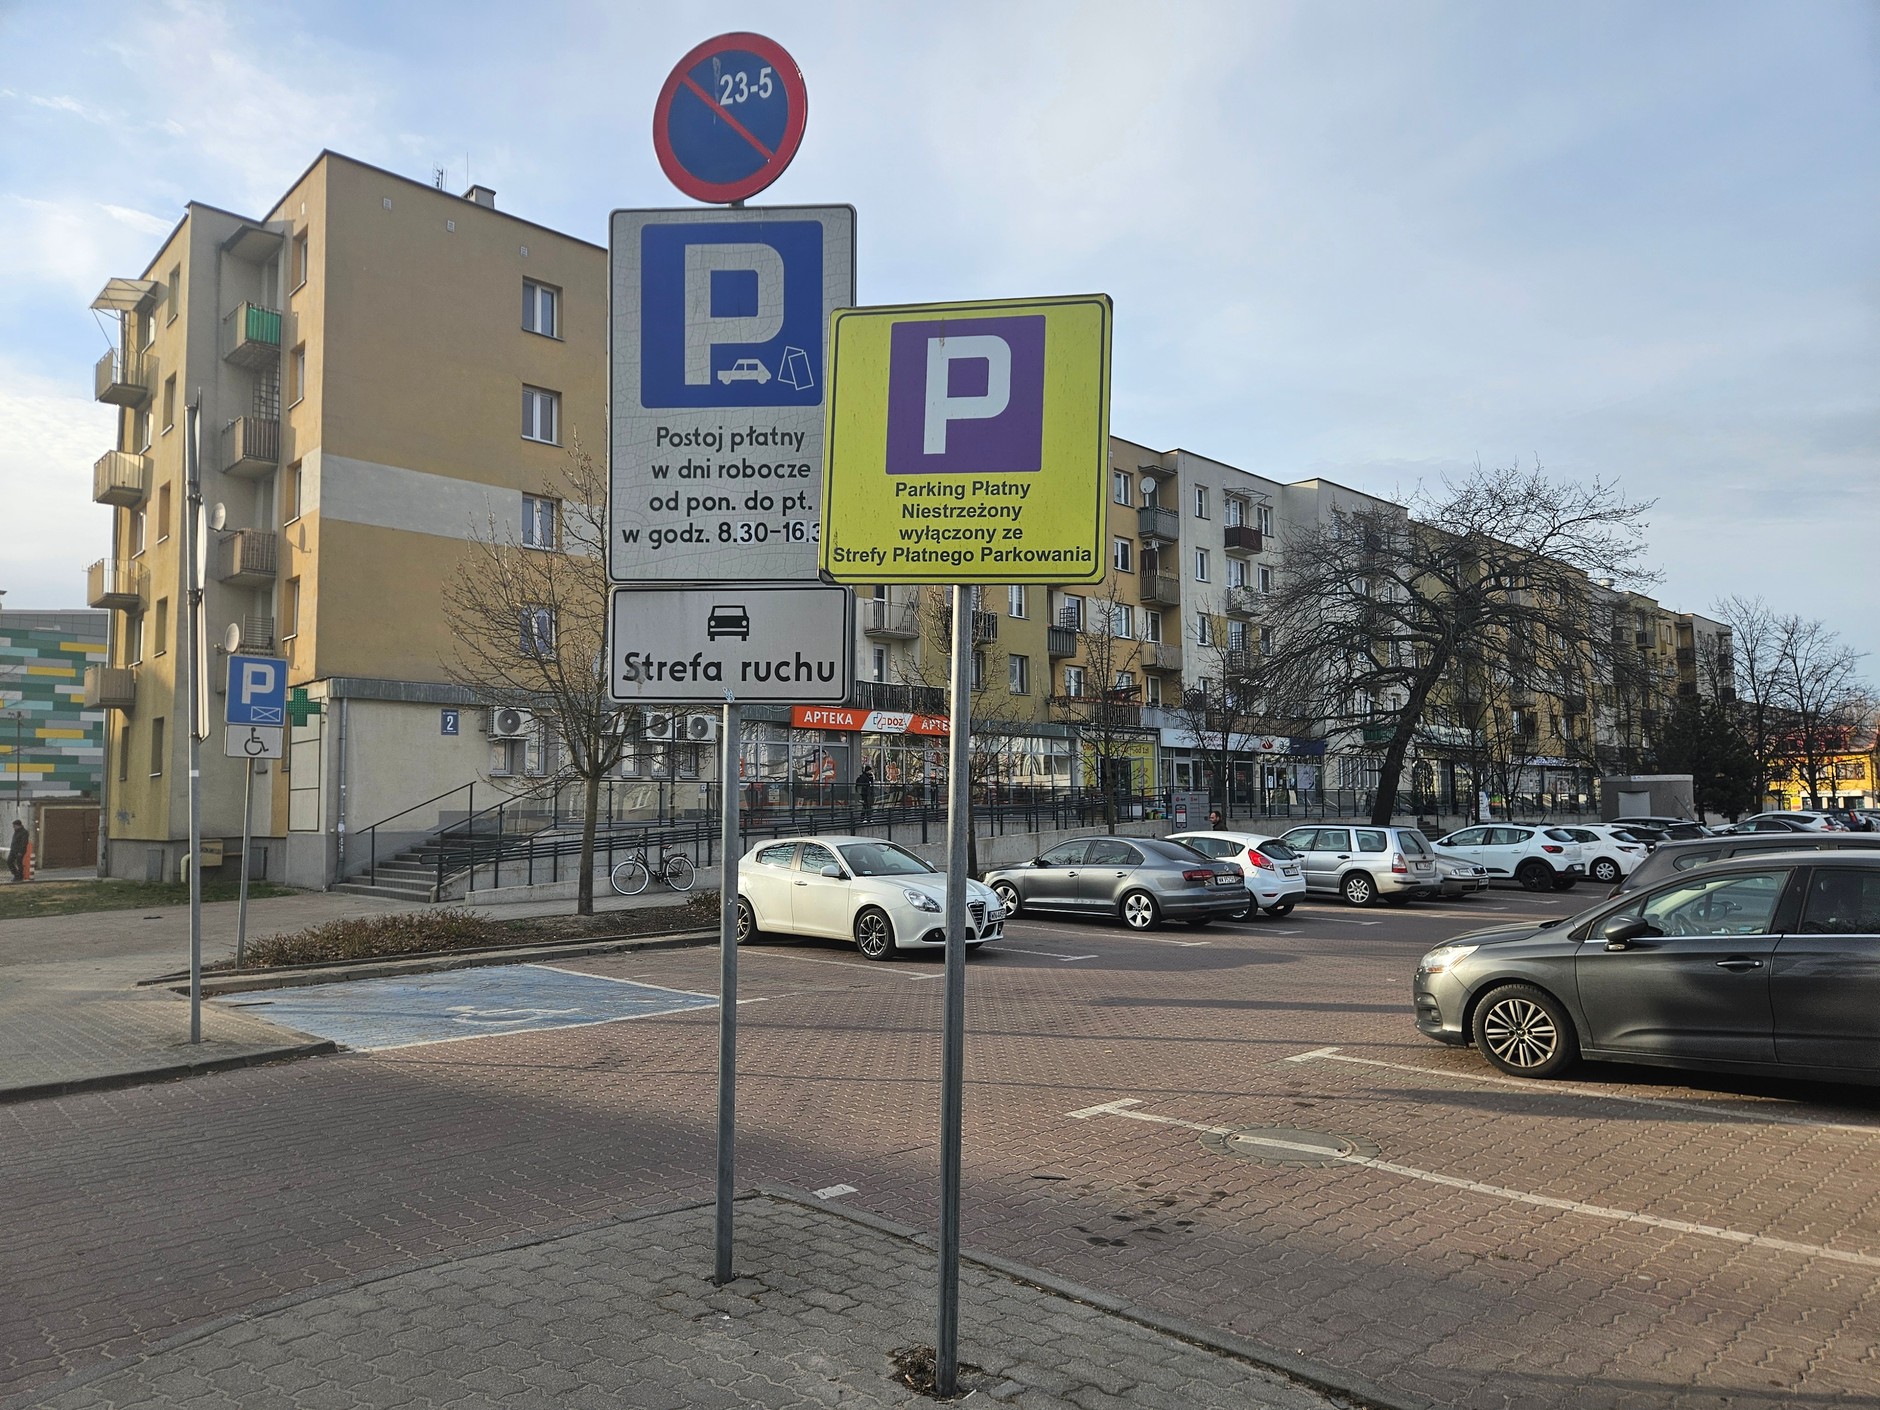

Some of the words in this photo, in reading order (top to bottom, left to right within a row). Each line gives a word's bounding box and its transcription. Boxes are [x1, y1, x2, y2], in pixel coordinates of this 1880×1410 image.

[719, 67, 773, 106] 23-5
[684, 243, 785, 387] P
[923, 335, 1012, 456] P
[656, 425, 723, 453] Postoj
[730, 425, 806, 453] płatny
[651, 465, 670, 479] w
[677, 457, 711, 479] dni
[718, 457, 811, 479] robocze
[649, 490, 679, 512] od
[686, 496, 736, 517] pon.
[744, 489, 774, 511] do
[782, 489, 813, 517] pt.
[895, 481, 966, 500] Parking
[971, 480, 1031, 500] Płatny
[902, 502, 1023, 522] Niestrzeżony
[621, 529, 641, 544] w
[648, 522, 710, 550] godz.
[718, 520, 820, 544] 8.30-16.3
[898, 525, 997, 545] wyłączony
[1001, 528, 1024, 541] ze
[833, 546, 887, 566] Strefy
[892, 546, 975, 566] Płatnego
[980, 545, 1092, 563] Parkowania
[622, 651, 723, 683] Strefa
[741, 651, 835, 683] ruchu
[241, 663, 275, 704] P
[446, 715, 454, 731] 2
[803, 710, 854, 726] APTEKA
[920, 718, 950, 731] APTE
